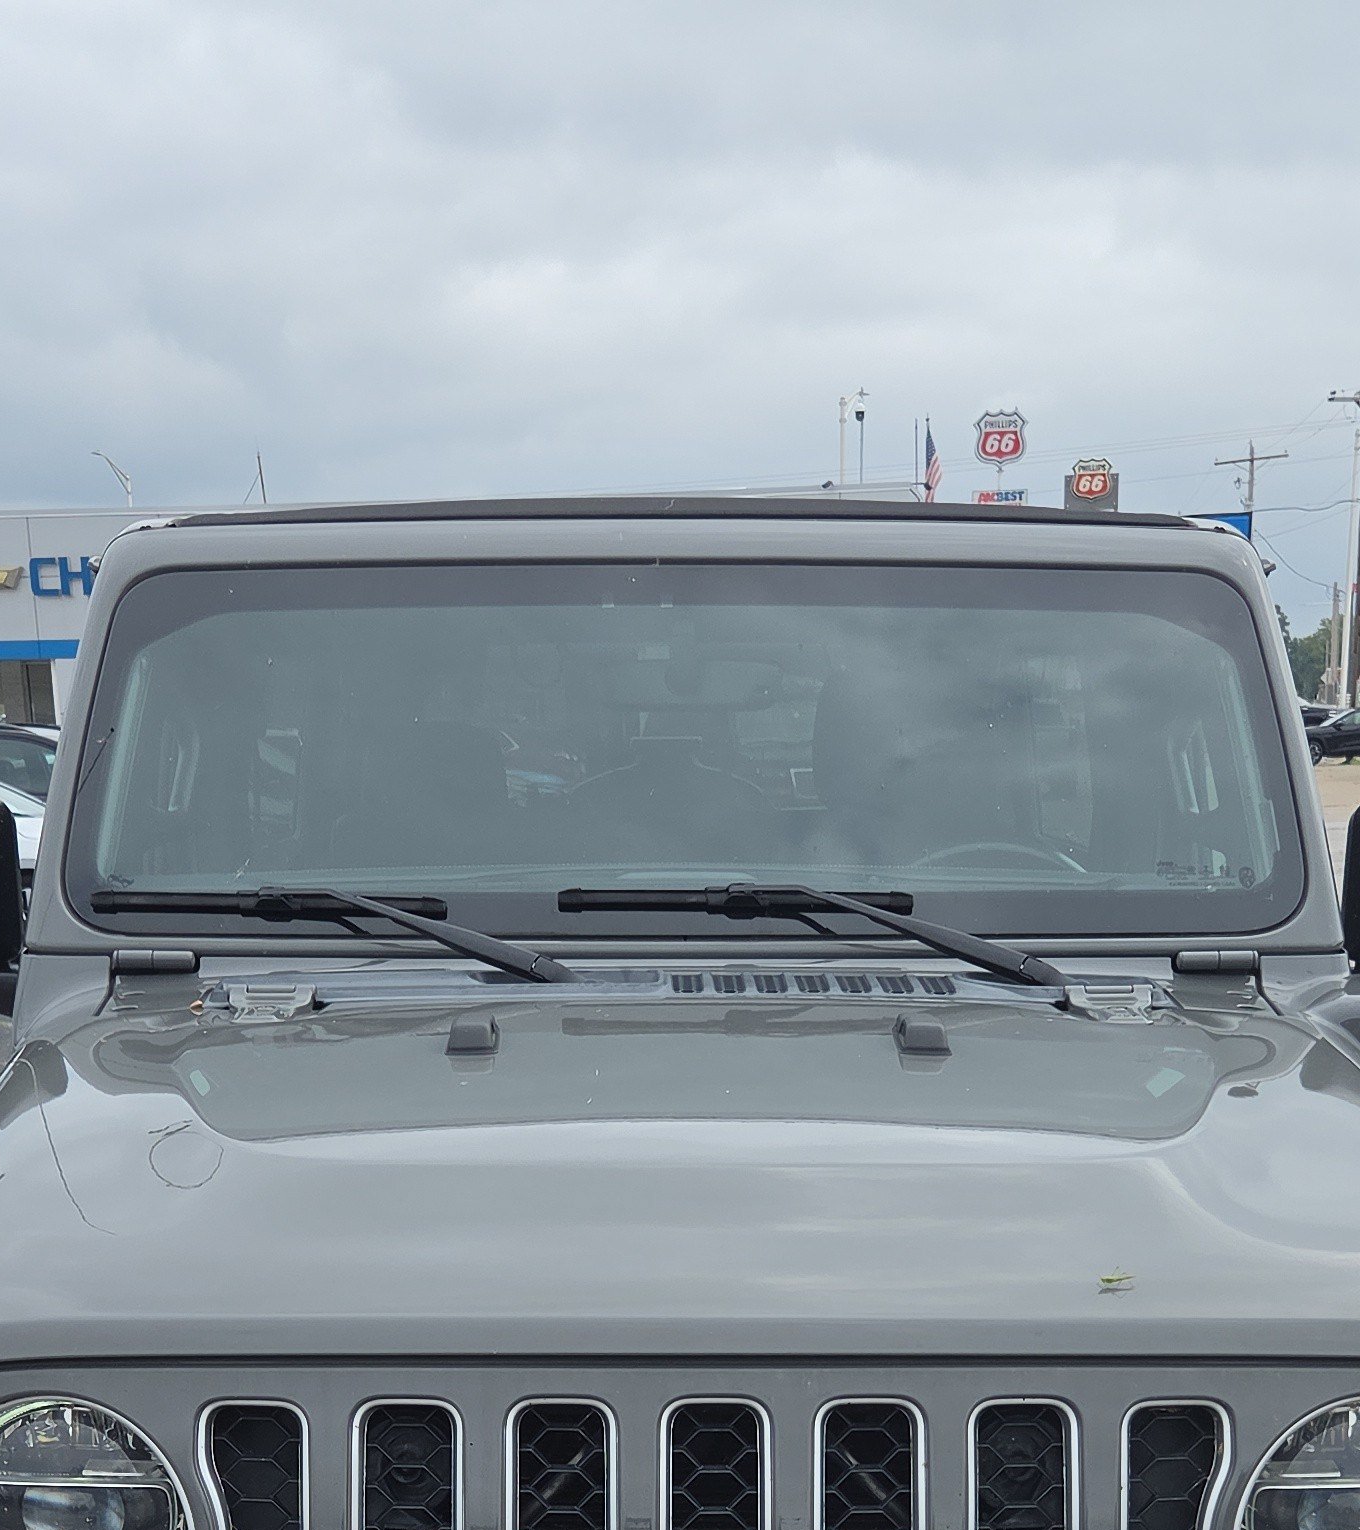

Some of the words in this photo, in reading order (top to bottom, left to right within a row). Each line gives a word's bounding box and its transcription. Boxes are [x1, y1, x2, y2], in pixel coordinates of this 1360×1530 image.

[984, 419, 1018, 429] PHILLIPS
[985, 433, 1016, 453] 66
[1078, 475, 1105, 492] 66
